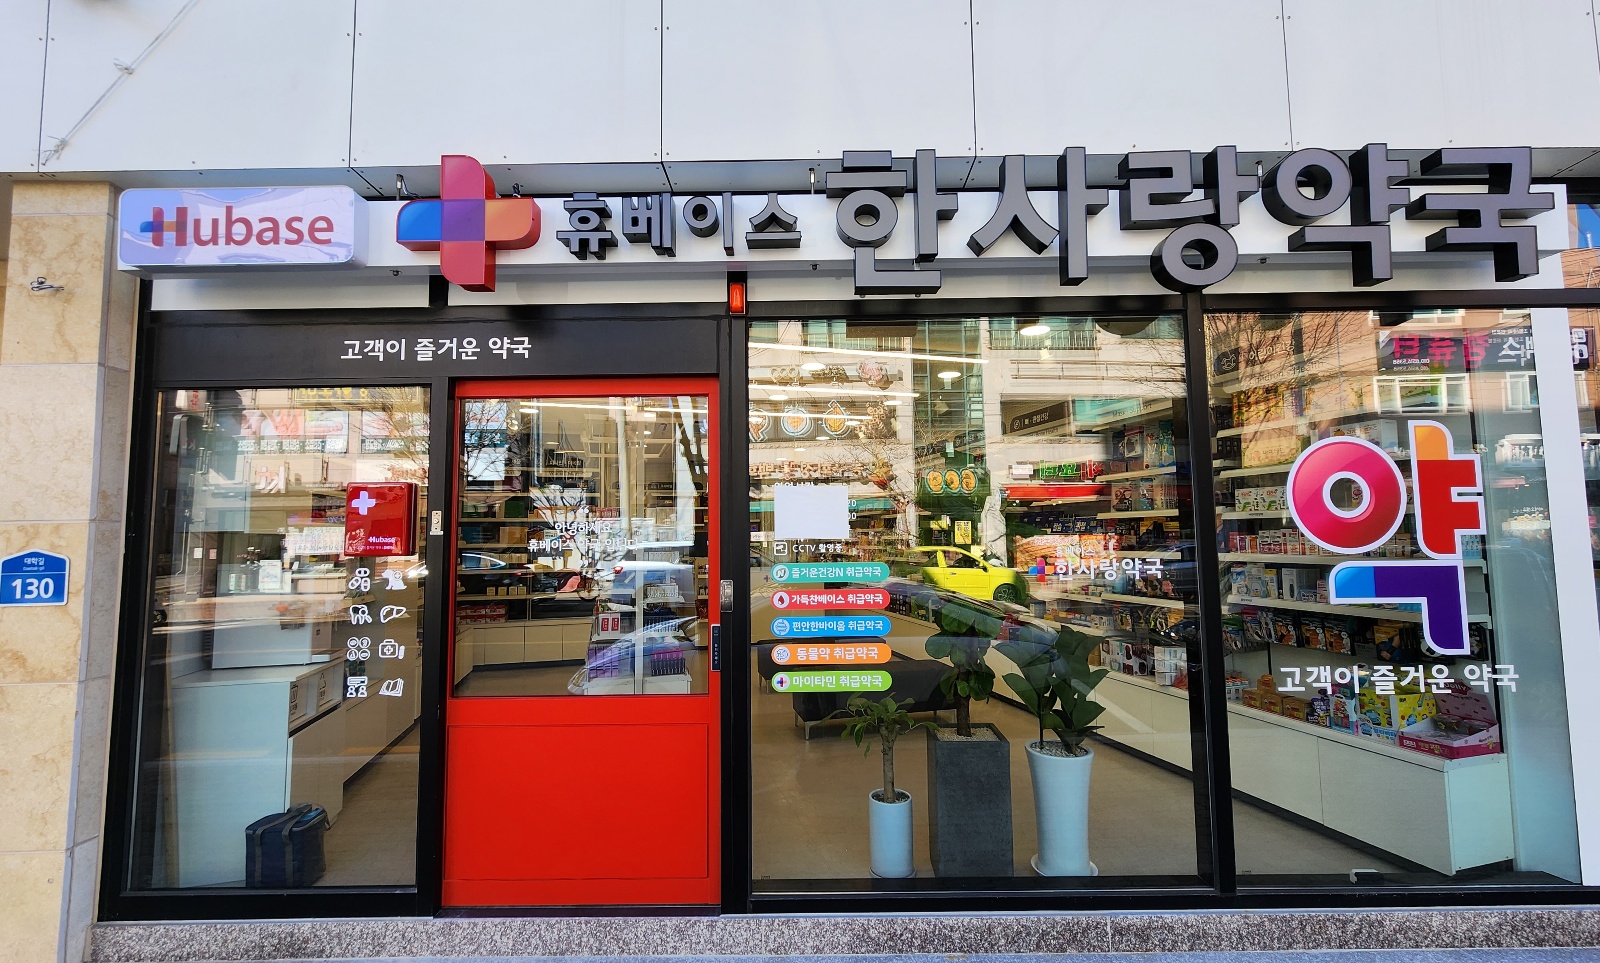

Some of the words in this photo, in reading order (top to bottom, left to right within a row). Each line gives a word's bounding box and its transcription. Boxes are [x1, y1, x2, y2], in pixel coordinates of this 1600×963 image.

[556, 192, 801, 259] 휴베이스
[826, 143, 1555, 294] 한사랑약국
[140, 206, 335, 247] Hubase
[341, 338, 406, 362] 고객이
[414, 337, 481, 362] 즐거운
[488, 336, 532, 360] 약국
[555, 521, 612, 536] 안녕하세요
[1287, 419, 1487, 656] 약
[528, 539, 574, 552] 휴베이스
[792, 544, 816, 553] CCTV
[1056, 547, 1095, 557] 휴베이스
[23, 557, 45, 566] 대학길
[1055, 557, 1164, 581] 한사랑약국
[791, 567, 844, 578] 즐거운건강N
[845, 566, 882, 578] 취급약국
[11, 577, 55, 600] 130
[847, 593, 884, 605] 취급약국
[792, 620, 846, 632] 편안한바이옴
[847, 620, 884, 631] 취급약국
[796, 647, 831, 661] 동물약
[833, 646, 879, 660] 취급약국
[792, 675, 836, 688] 마이타민
[839, 675, 883, 688] 취급약국
[1278, 665, 1360, 694] 고객이
[1370, 664, 1454, 695] 즐거운
[1463, 663, 1520, 693] 약국
